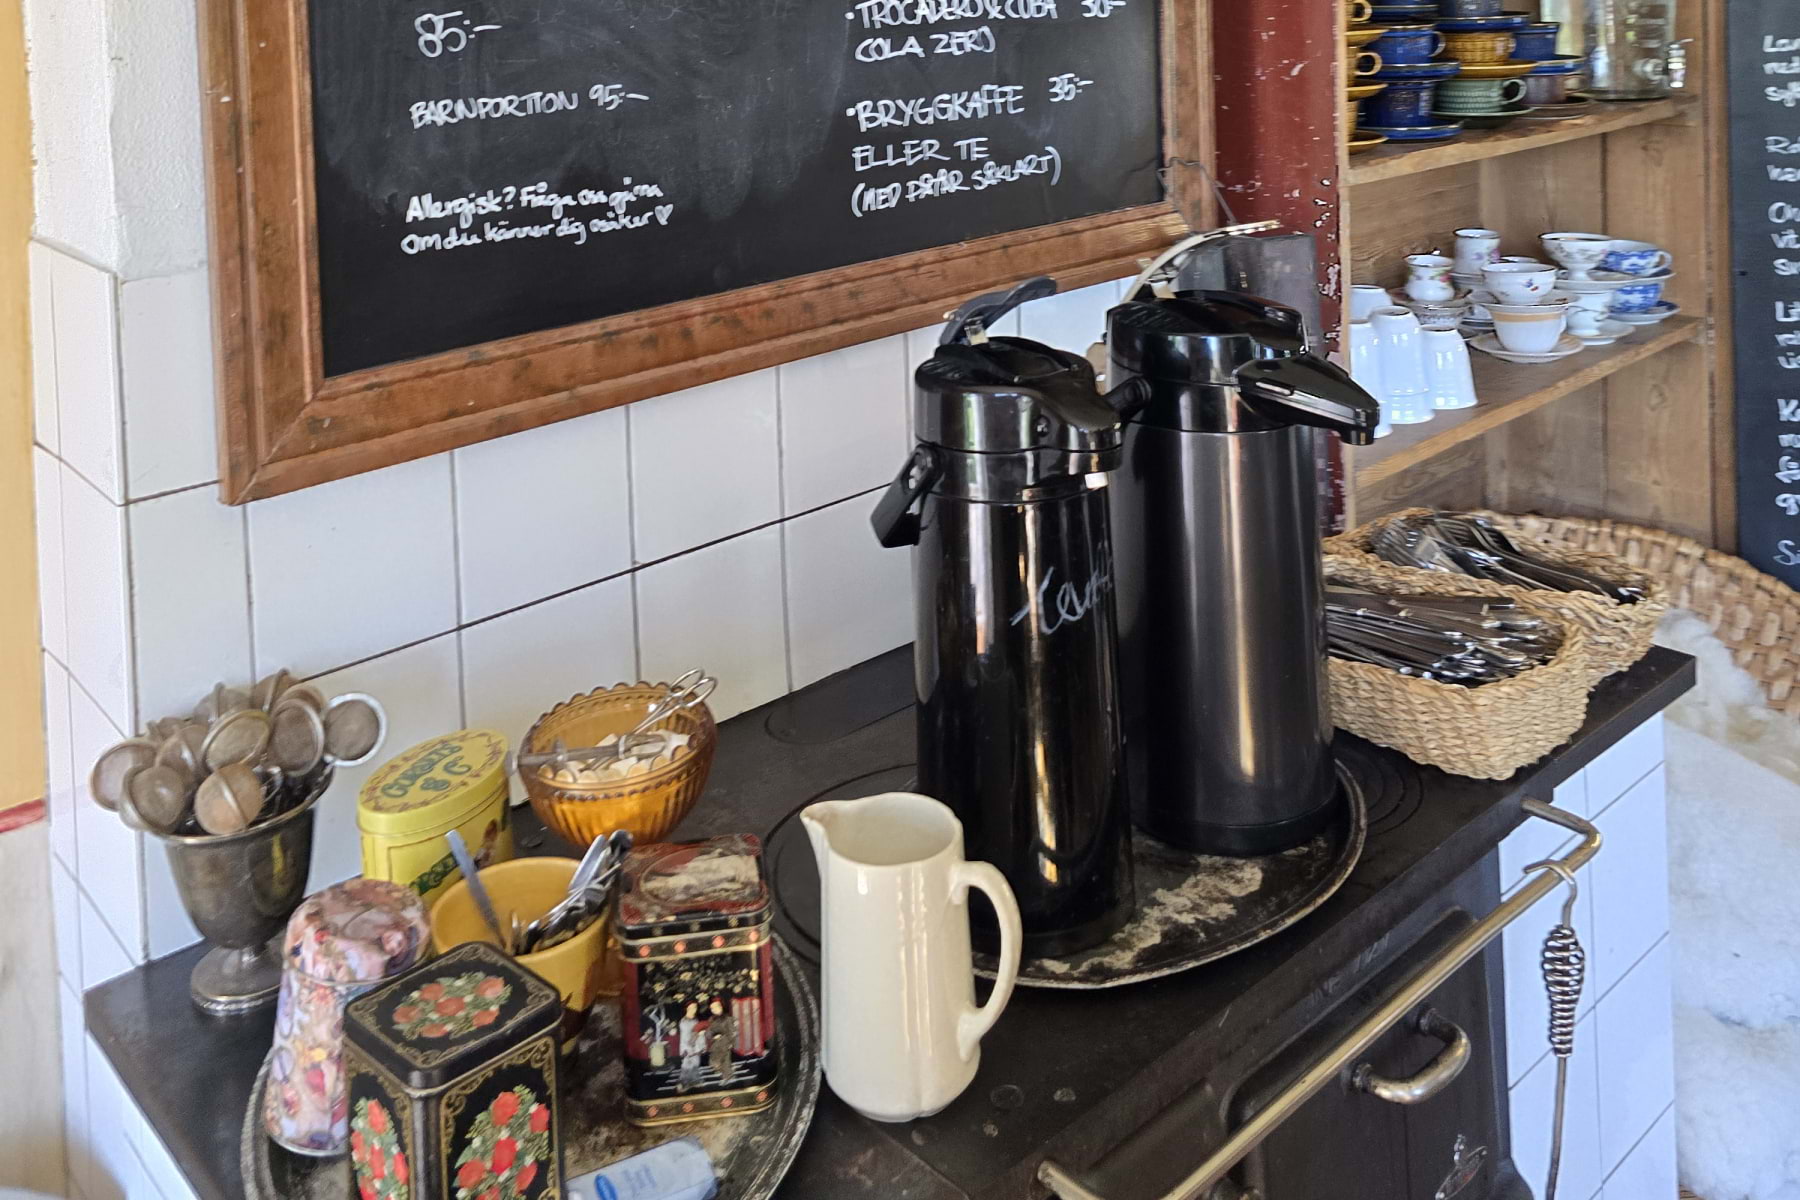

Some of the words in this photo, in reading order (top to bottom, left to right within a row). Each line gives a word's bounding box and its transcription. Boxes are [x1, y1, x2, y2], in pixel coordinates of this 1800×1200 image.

[855, 35, 926, 64] COLA
[929, 24, 997, 56] ZERO
[409, 89, 580, 129] BARNPORTION
[855, 83, 1026, 133] BRYGGKAFFE
[851, 139, 952, 173] ELLER
[953, 136, 991, 162] TE
[442, 227, 483, 250] du
[555, 217, 587, 246] dig
